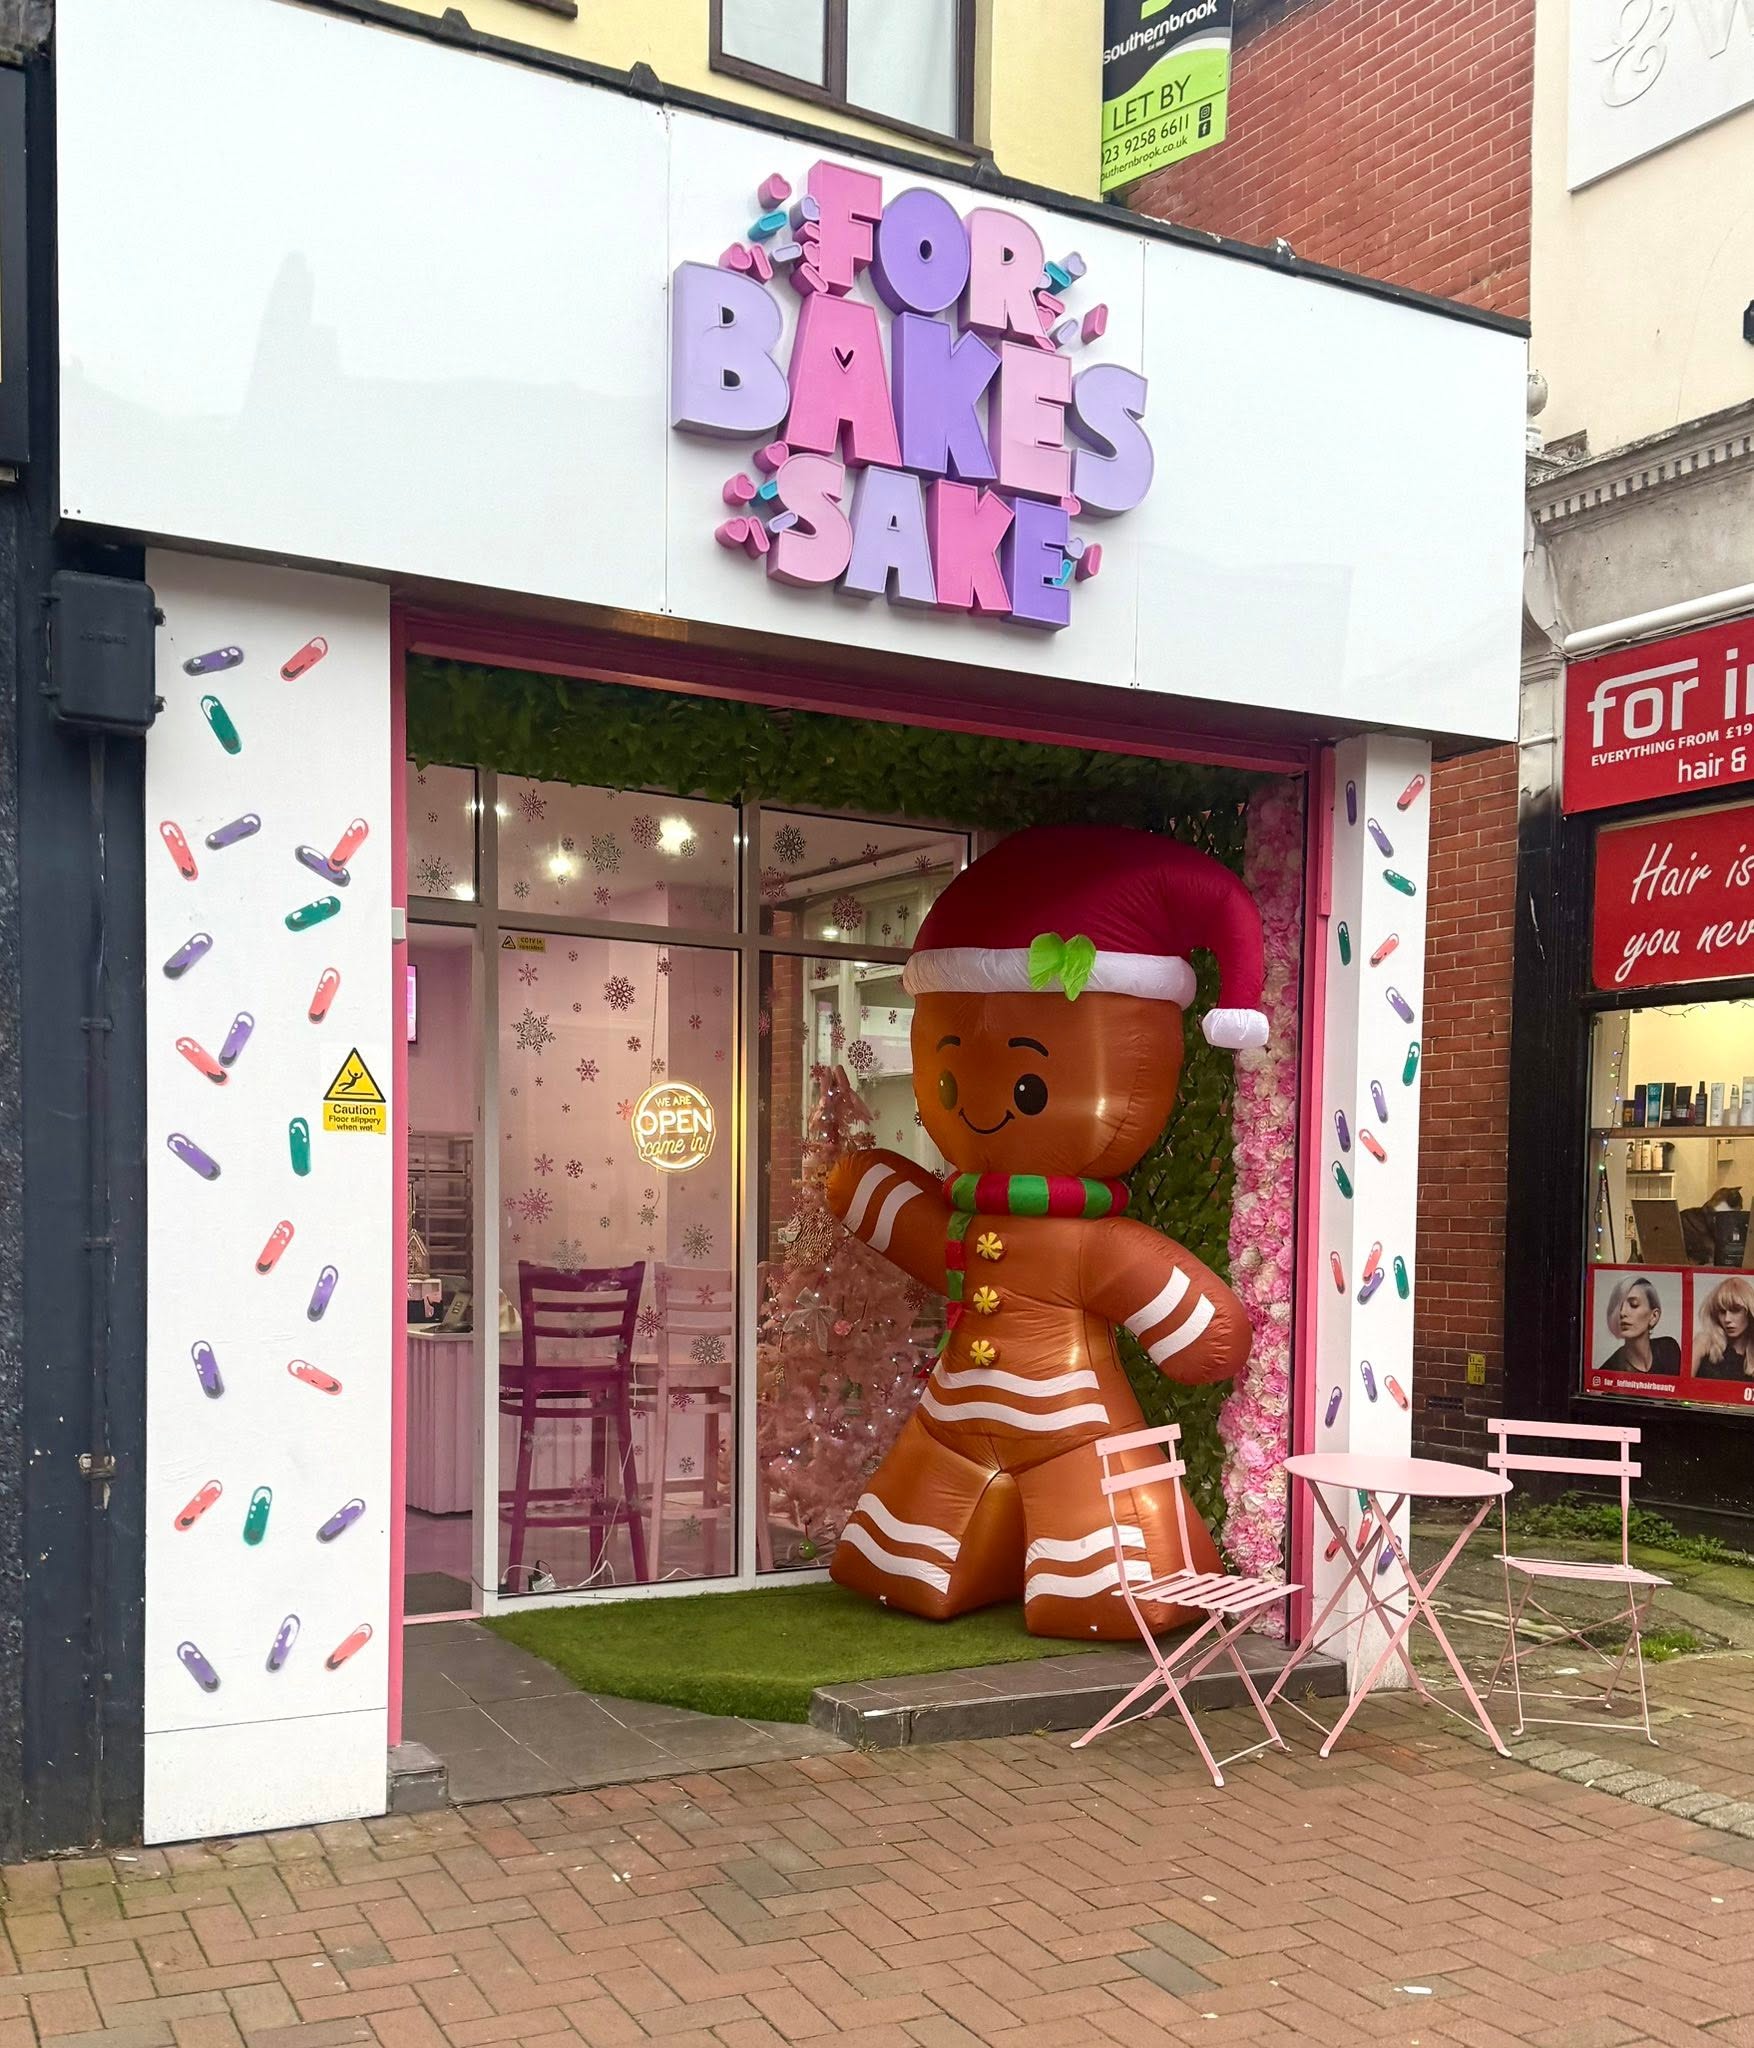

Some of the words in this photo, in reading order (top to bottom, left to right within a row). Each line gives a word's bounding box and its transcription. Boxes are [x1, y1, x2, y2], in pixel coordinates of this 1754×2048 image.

[1103, 1, 1217, 64] southernbrook
[1112, 90, 1154, 131] LET
[1160, 74, 1192, 110] BY
[1124, 128, 1156, 155] 9258
[1160, 113, 1189, 138] 6611
[798, 160, 1056, 351] FOR
[672, 260, 1155, 517] BAKES
[766, 452, 1072, 631] SAKE
[1587, 657, 1699, 748] for
[1724, 648, 1754, 717] i
[1591, 738, 1675, 767] EVERYTHING
[1678, 730, 1719, 749] FROM
[1678, 752, 1724, 783] hair
[1731, 746, 1747, 773] &
[1630, 842, 1712, 904] Hair
[1725, 844, 1754, 889] is
[1615, 928, 1680, 982] you
[333, 1103, 376, 1115] Caution
[636, 1107, 712, 1136] OPEN
[655, 1097, 671, 1107] WE
[672, 1095, 692, 1106] ARE
[336, 1123, 358, 1131] when
[644, 1138, 686, 1156] come
[1744, 1387, 1754, 1401] 0
